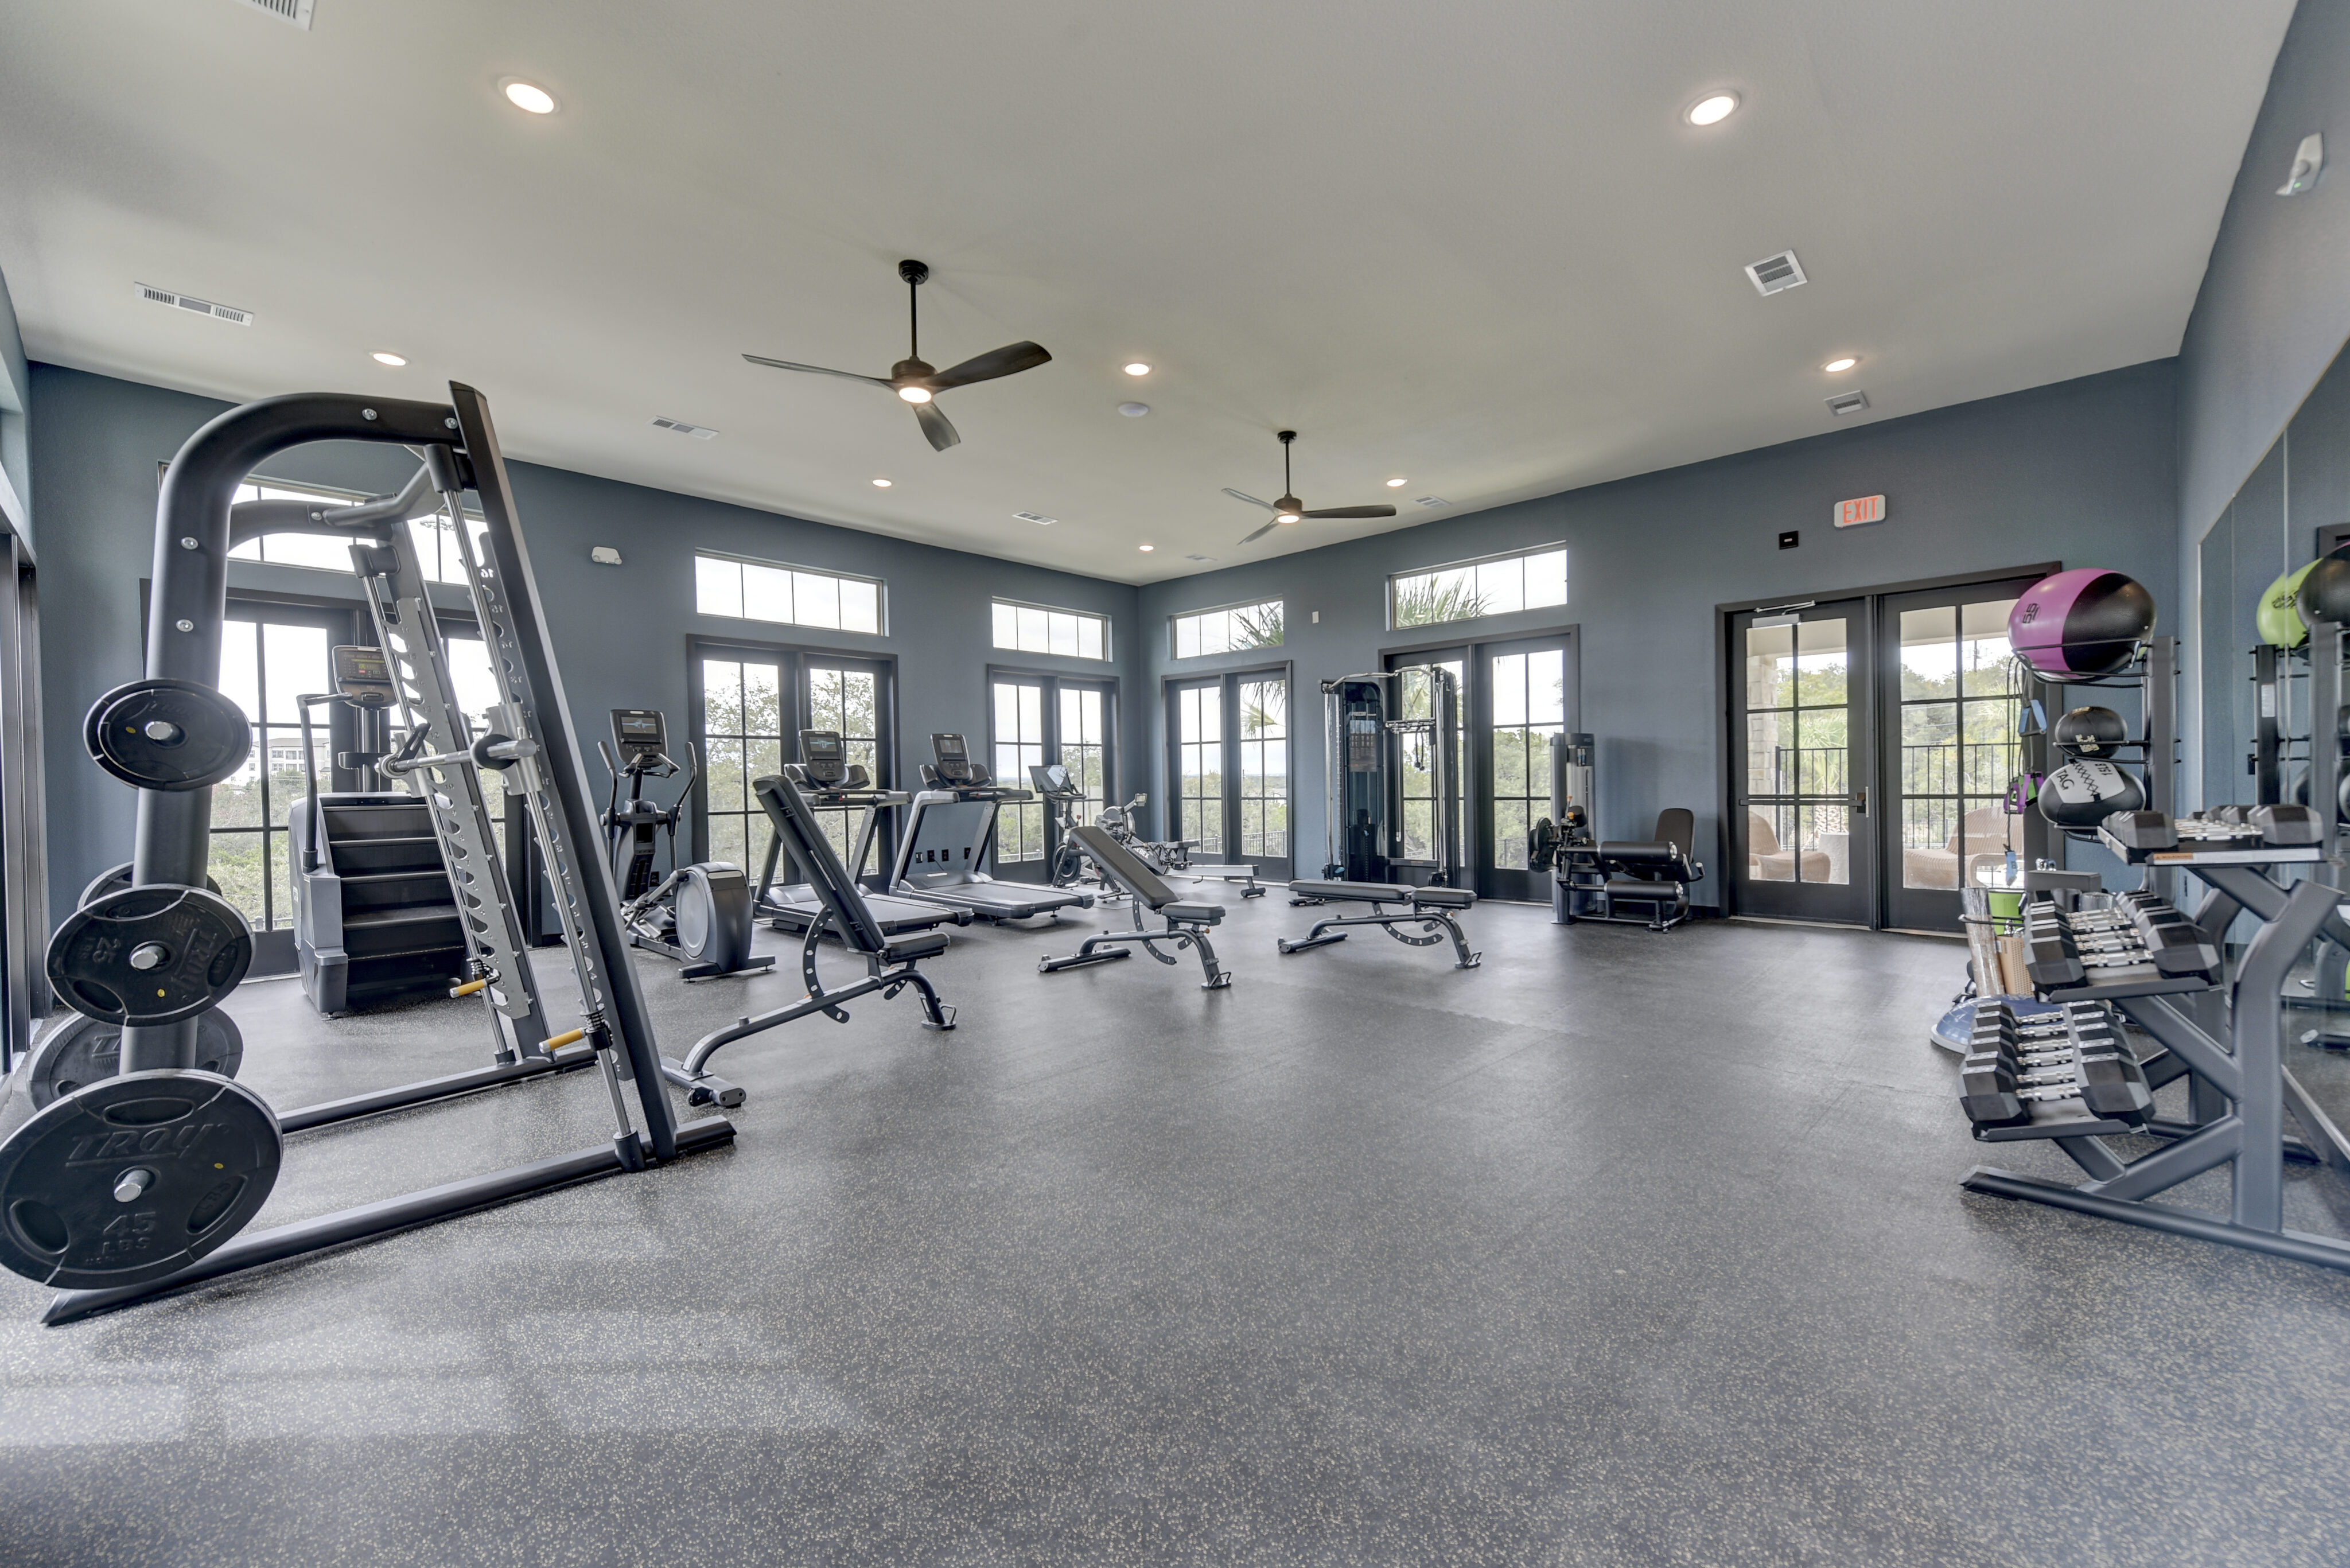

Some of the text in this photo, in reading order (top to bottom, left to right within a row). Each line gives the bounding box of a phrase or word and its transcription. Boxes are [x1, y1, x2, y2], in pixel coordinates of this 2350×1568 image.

[1842, 496, 1880, 524] EXIT
[92, 936, 121, 963] 25
[68, 1123, 214, 1161] TROY
[103, 1211, 156, 1236] 45
[102, 1237, 151, 1255] LBS
